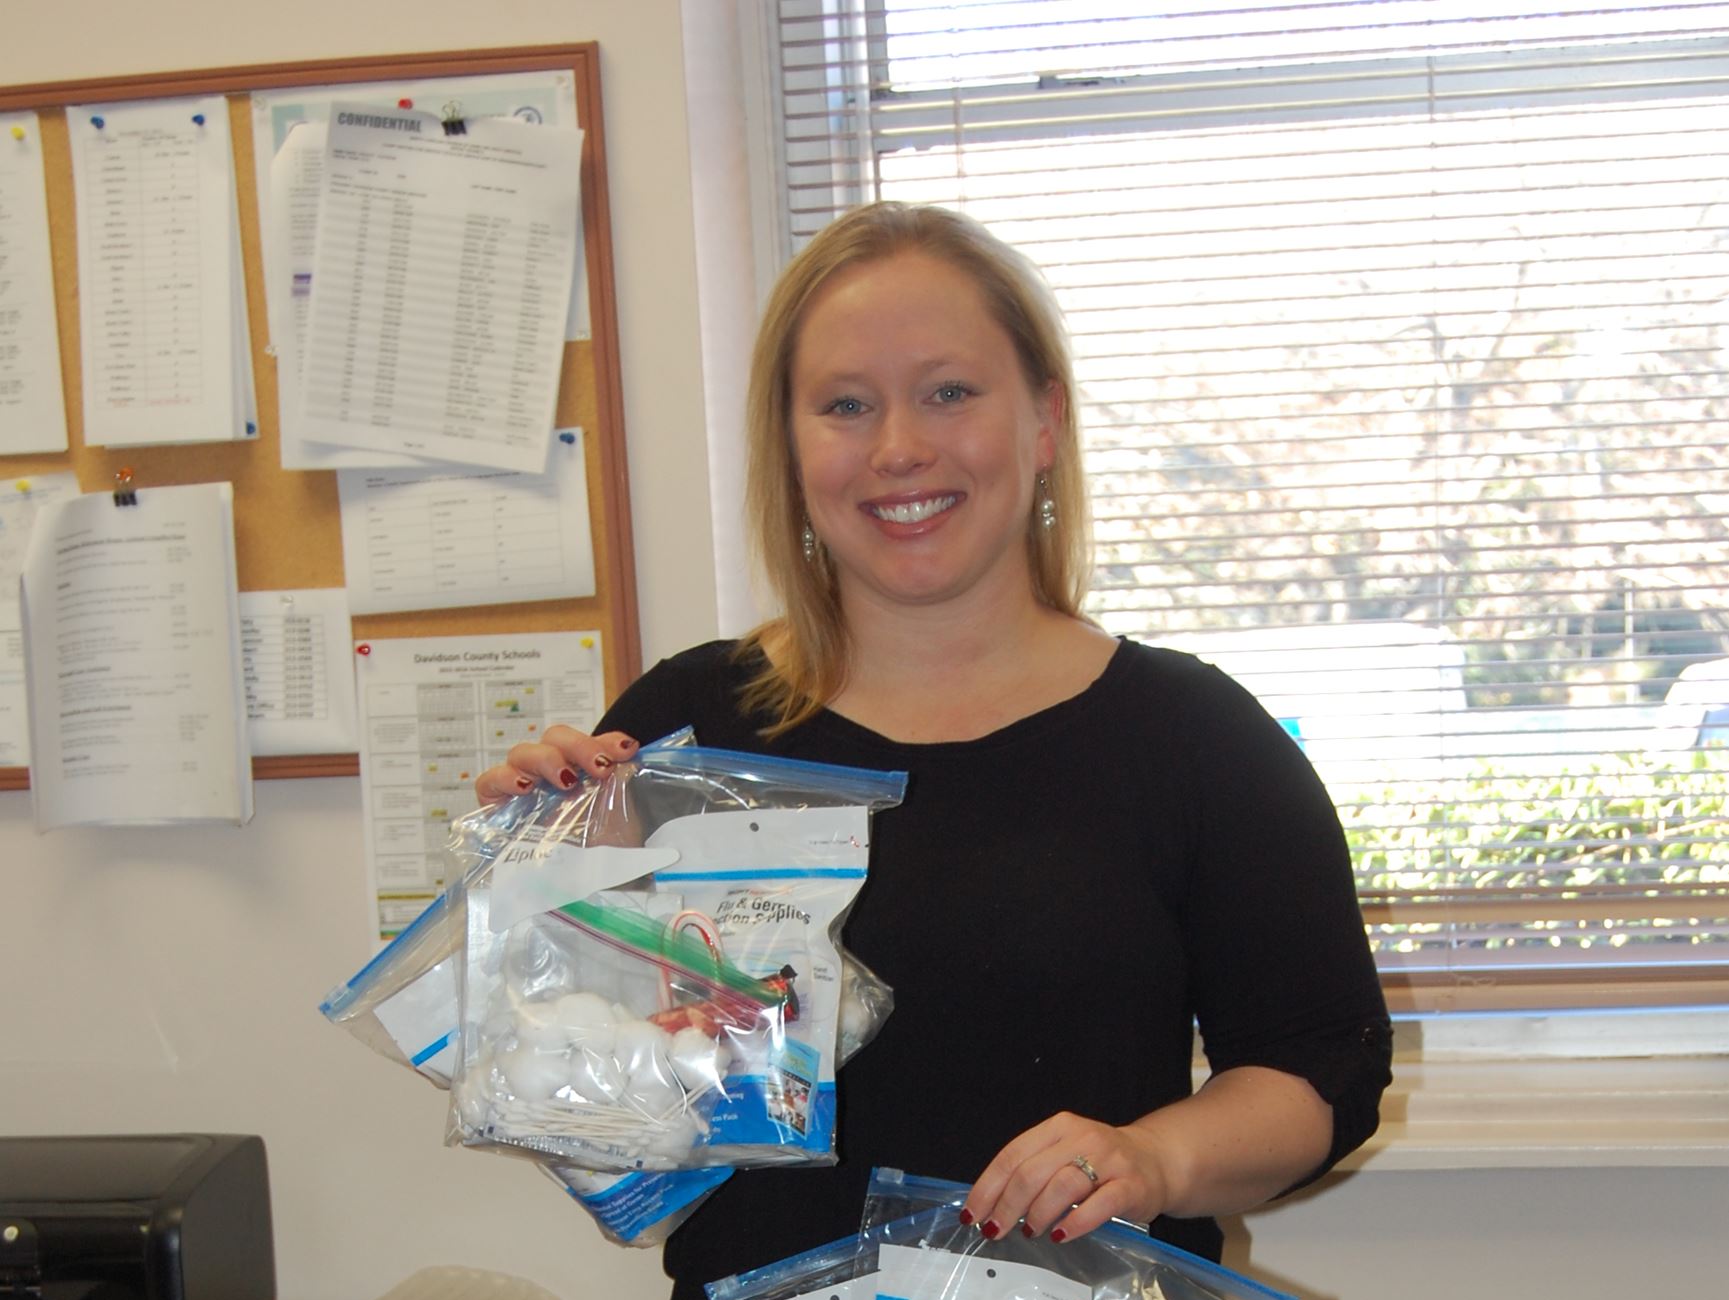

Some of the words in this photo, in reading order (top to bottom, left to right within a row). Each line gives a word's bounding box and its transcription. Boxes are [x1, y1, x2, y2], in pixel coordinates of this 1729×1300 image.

[336, 112, 422, 133] CONFIDENTIAL
[414, 652, 461, 664] Davidson
[463, 651, 499, 663] County
[502, 649, 542, 660] Schools
